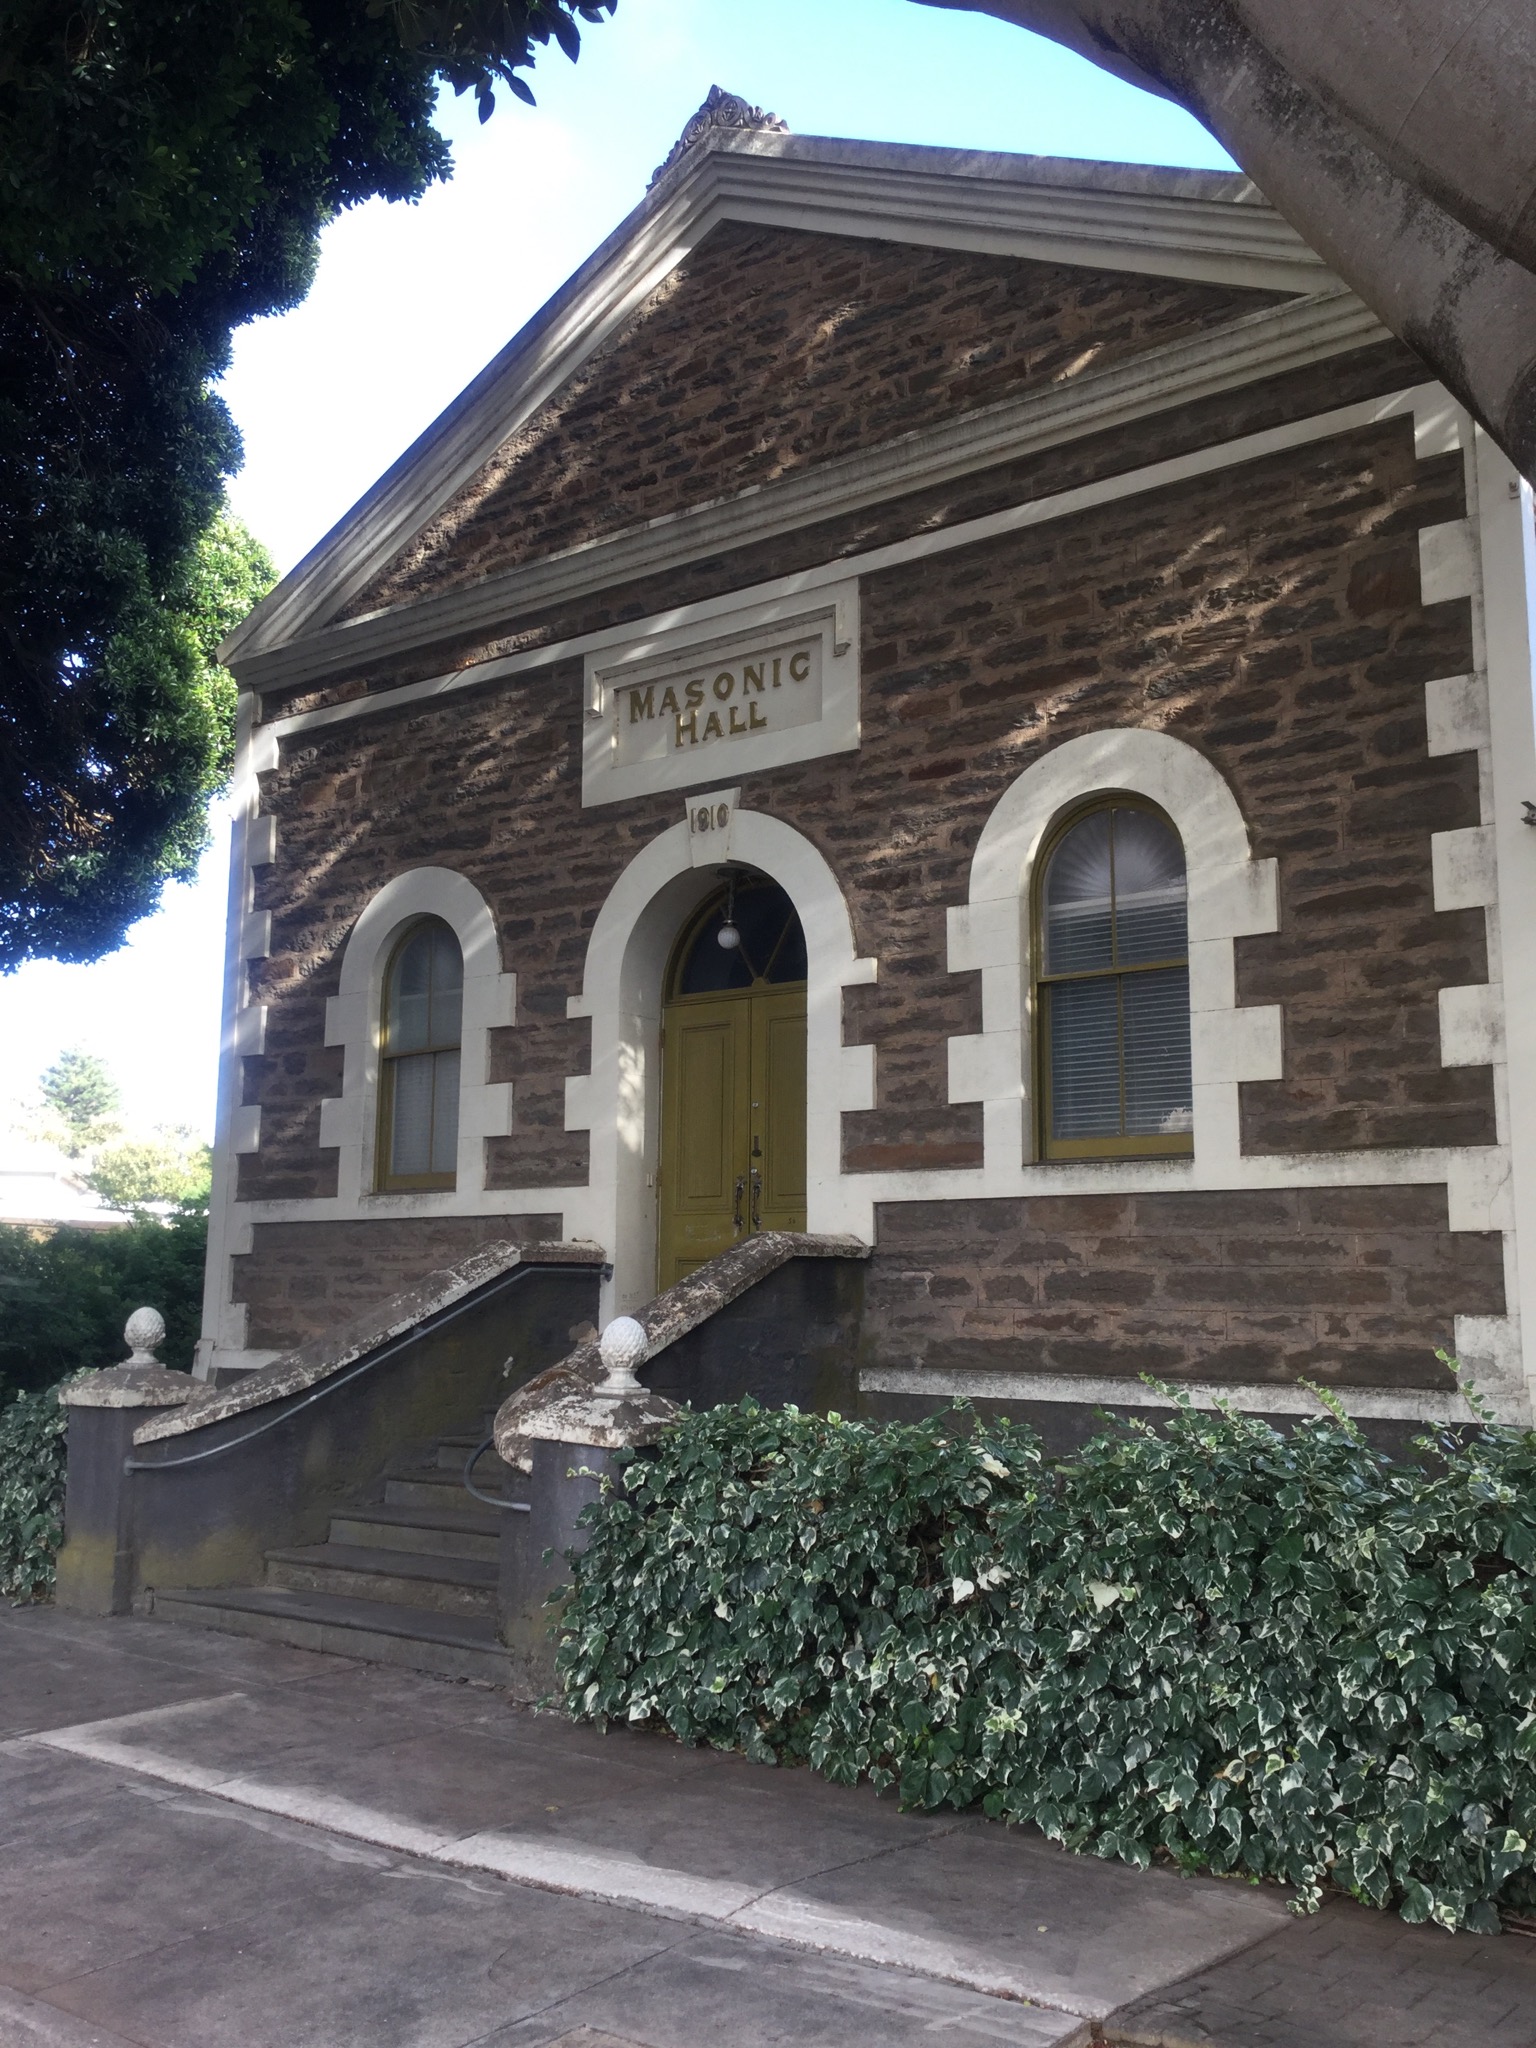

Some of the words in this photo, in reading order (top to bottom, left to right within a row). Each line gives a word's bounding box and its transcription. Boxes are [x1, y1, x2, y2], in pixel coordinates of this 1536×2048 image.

[630, 652, 811, 724] MASONIC
[675, 701, 767, 747] HALL
[690, 802, 730, 833] 1910
